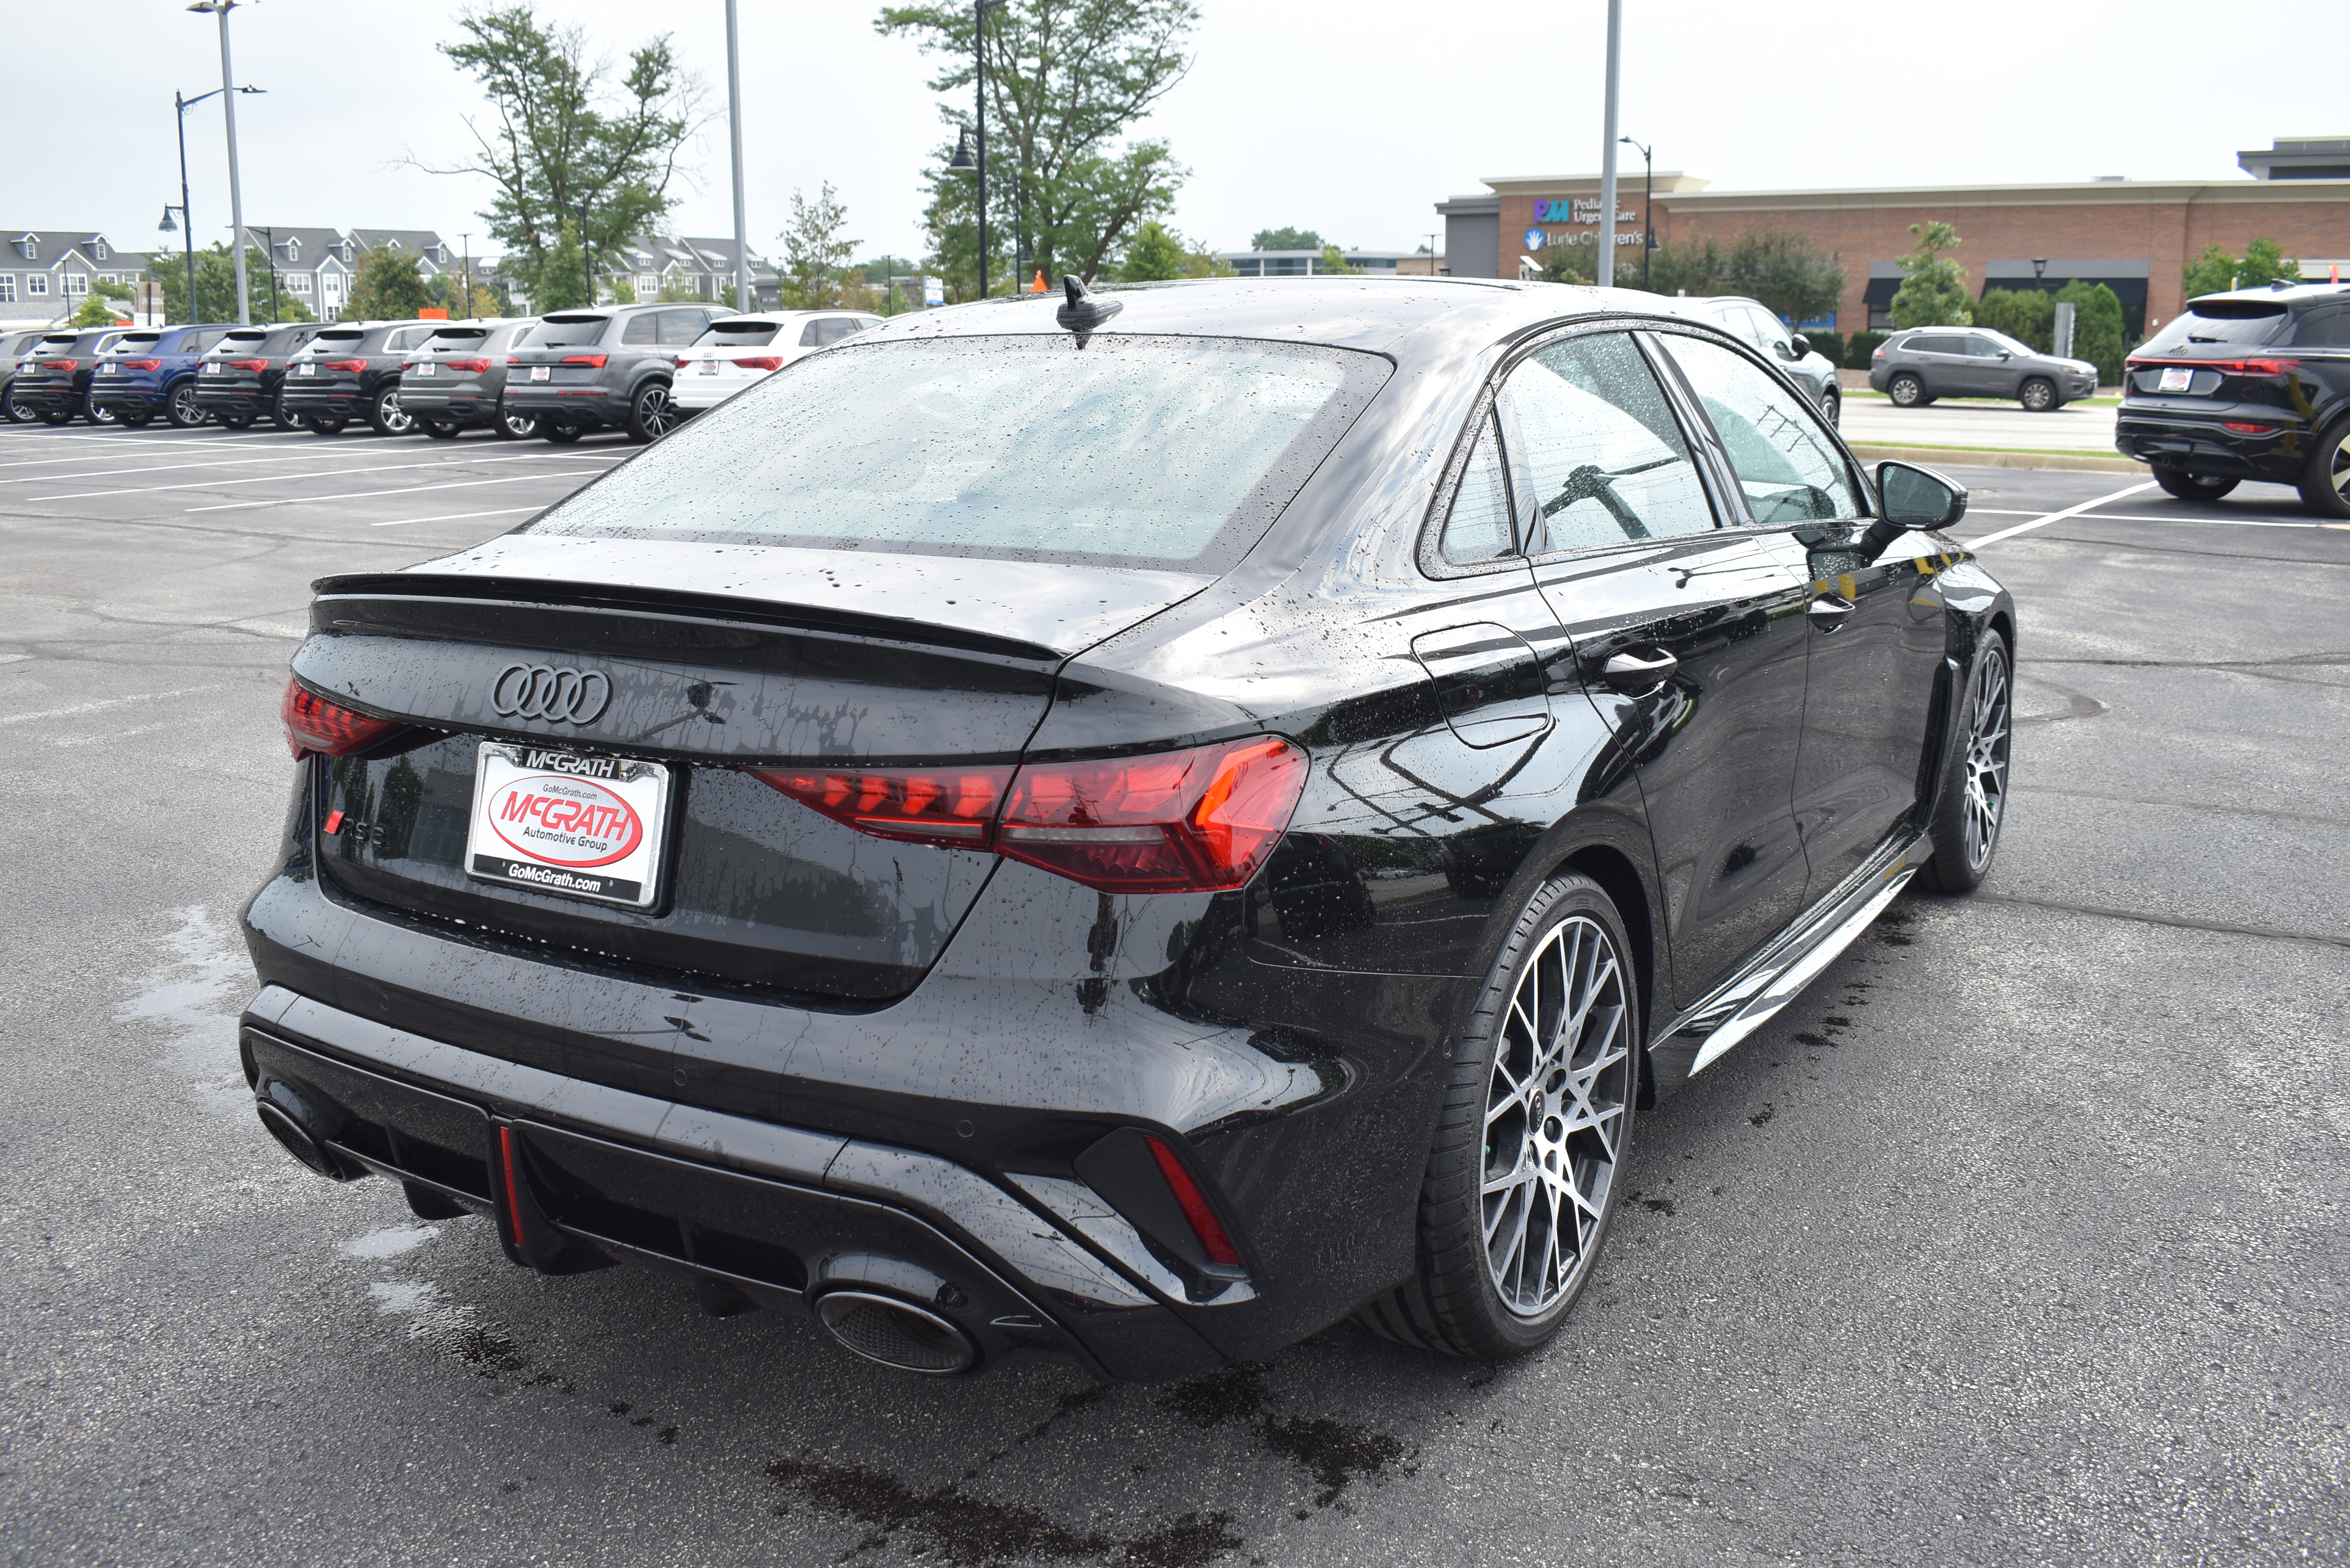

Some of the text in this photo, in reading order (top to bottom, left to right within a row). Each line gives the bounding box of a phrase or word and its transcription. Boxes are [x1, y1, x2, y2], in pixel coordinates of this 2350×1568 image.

[1547, 232, 1577, 247] Lurie
[526, 750, 615, 778] McGRATH
[543, 784, 597, 801] GoMcGrath.com
[500, 791, 631, 841] McGRATH
[523, 826, 608, 852] Automotive Group
[509, 863, 601, 892] GoMcGrath.com
